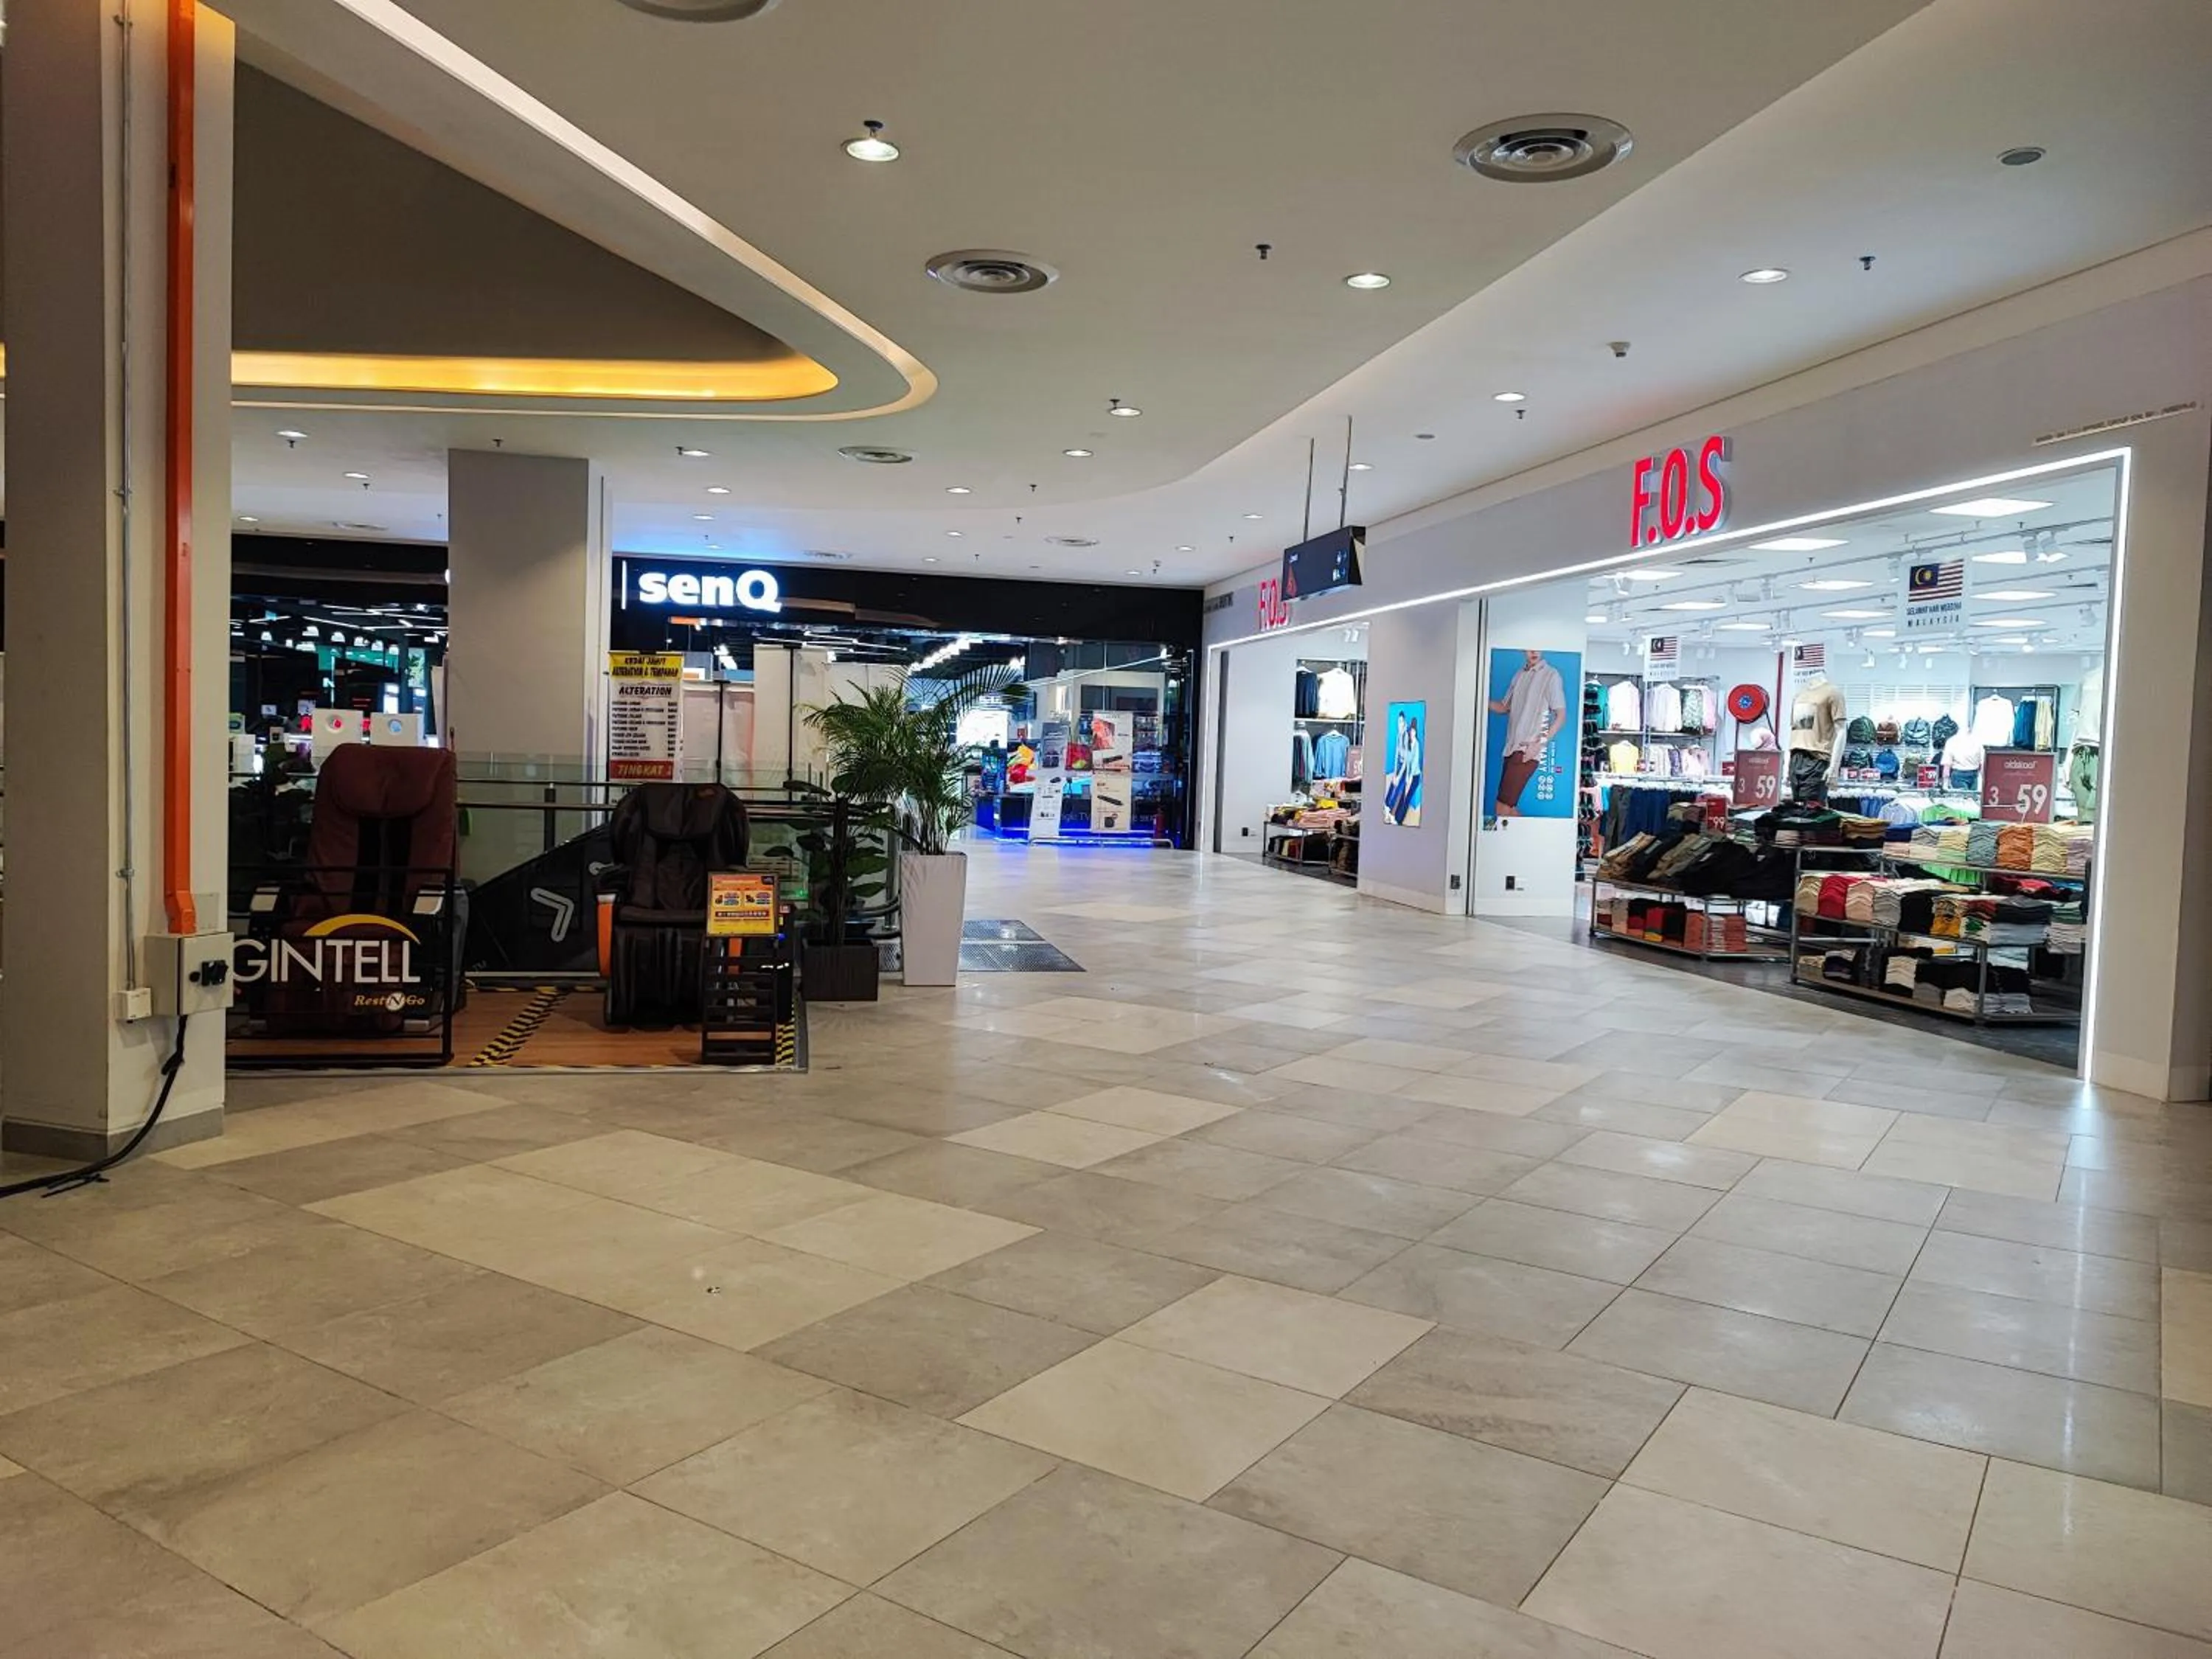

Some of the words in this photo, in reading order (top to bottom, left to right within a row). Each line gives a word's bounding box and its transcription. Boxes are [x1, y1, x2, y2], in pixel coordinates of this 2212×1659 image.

[1630, 435, 1727, 549] F.O.S
[639, 569, 782, 613] senQ
[619, 686, 672, 695] ALTERATION
[616, 764, 664, 776] TINGKAT
[1538, 747, 1548, 773] NAVY
[1737, 778, 1745, 793] 3
[1755, 775, 1776, 799] 59
[1988, 785, 2000, 805] 3
[2015, 784, 2048, 815] 59
[1713, 815, 1725, 830] 99
[232, 938, 421, 984] GINTELL
